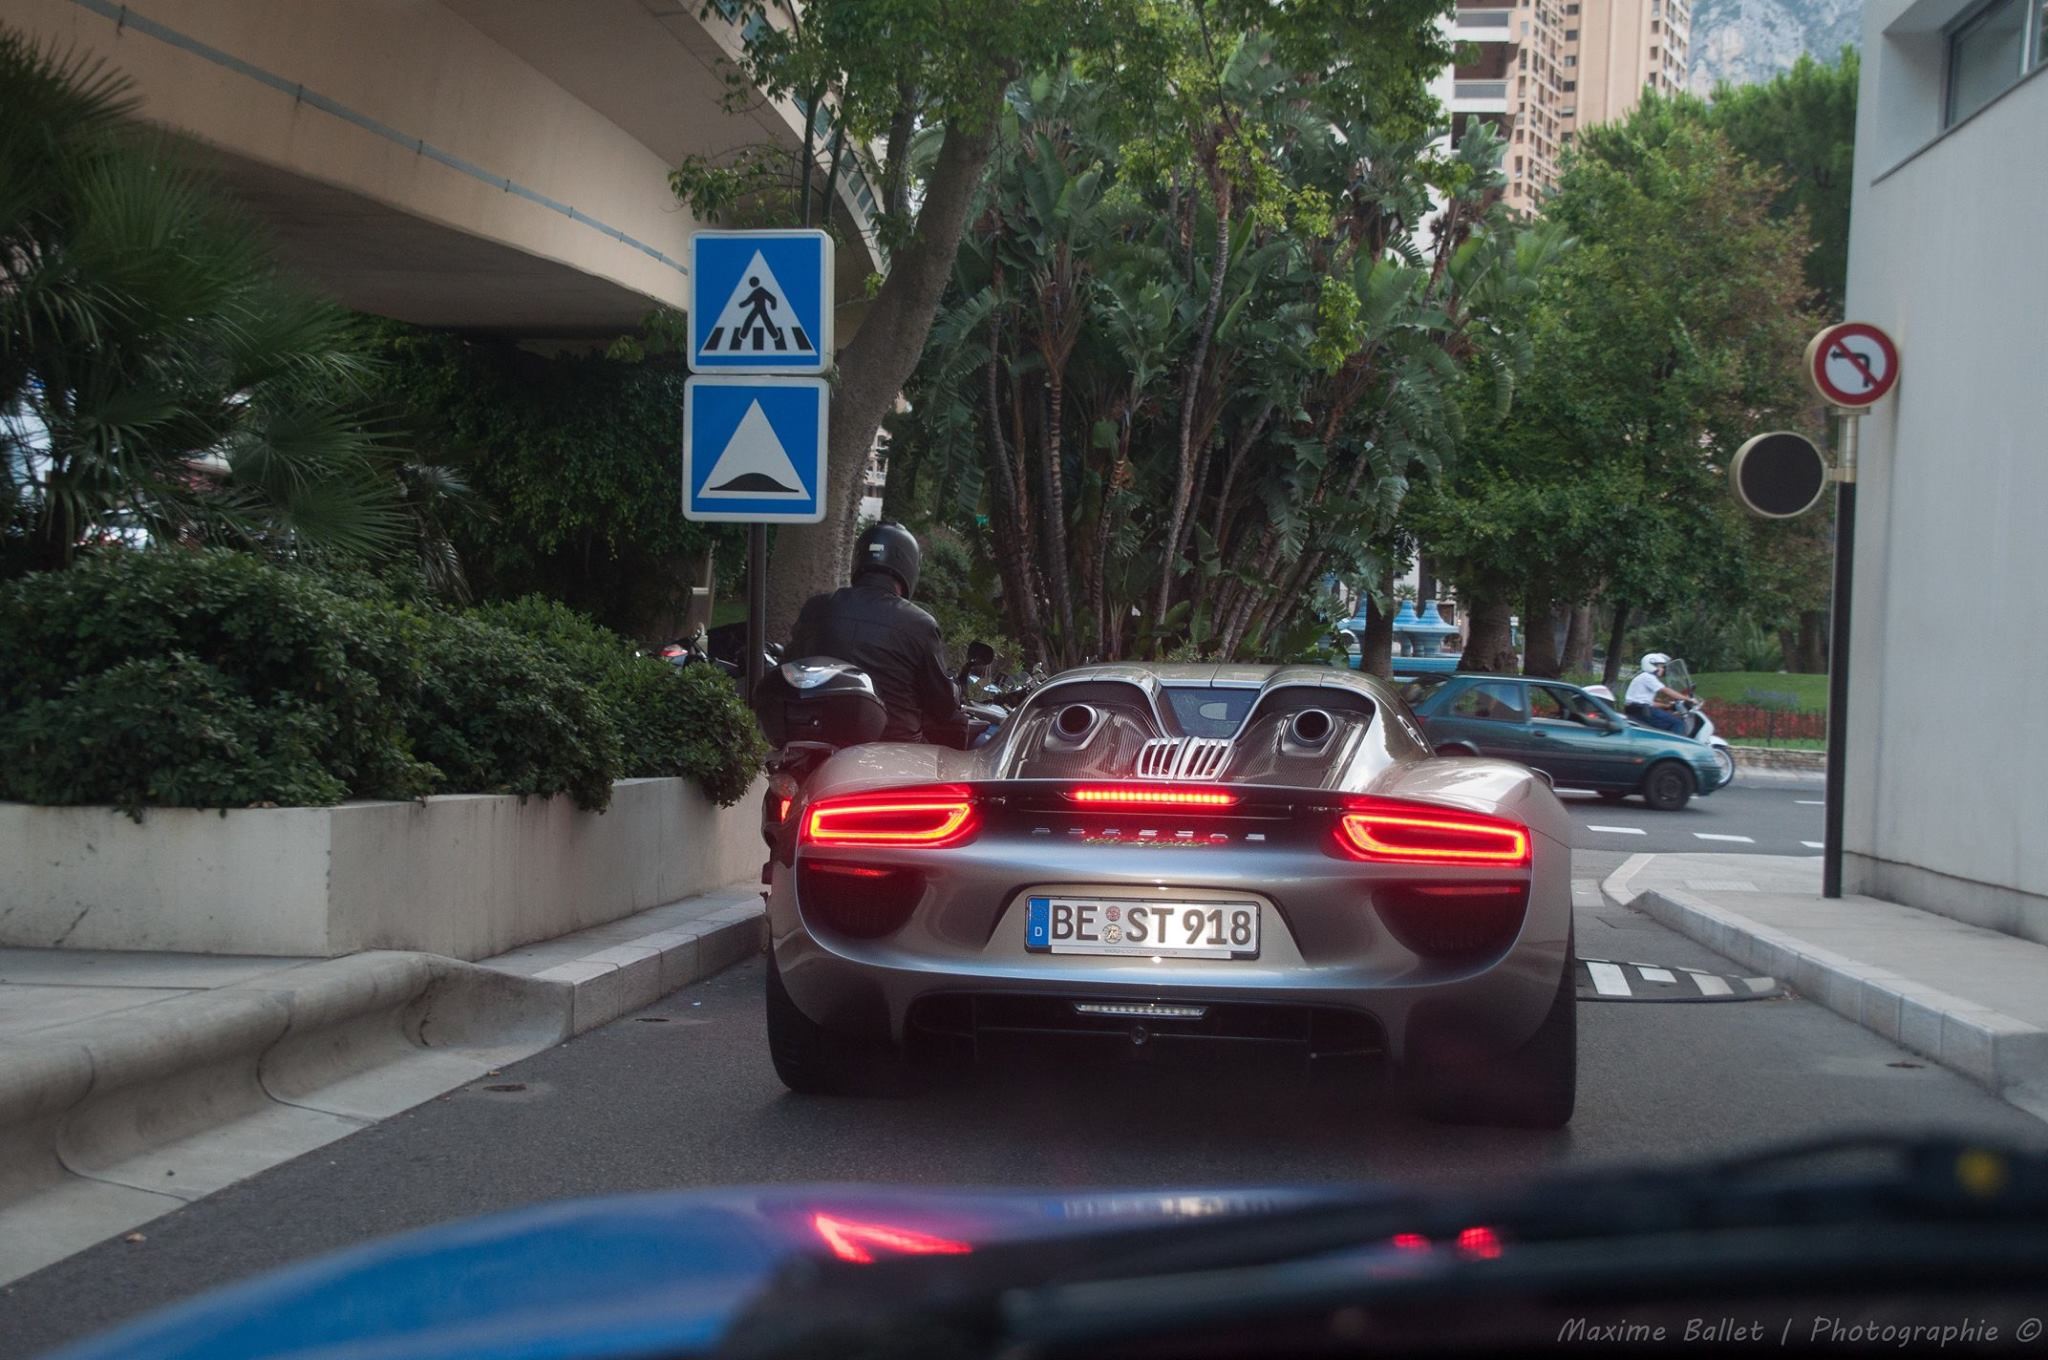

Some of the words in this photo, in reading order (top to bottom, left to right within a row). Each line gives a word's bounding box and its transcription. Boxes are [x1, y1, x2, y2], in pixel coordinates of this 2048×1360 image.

[1034, 926, 1043, 937] D
[1052, 904, 1099, 941] BE
[1126, 907, 1174, 944] ST
[1182, 909, 1251, 945] 918
